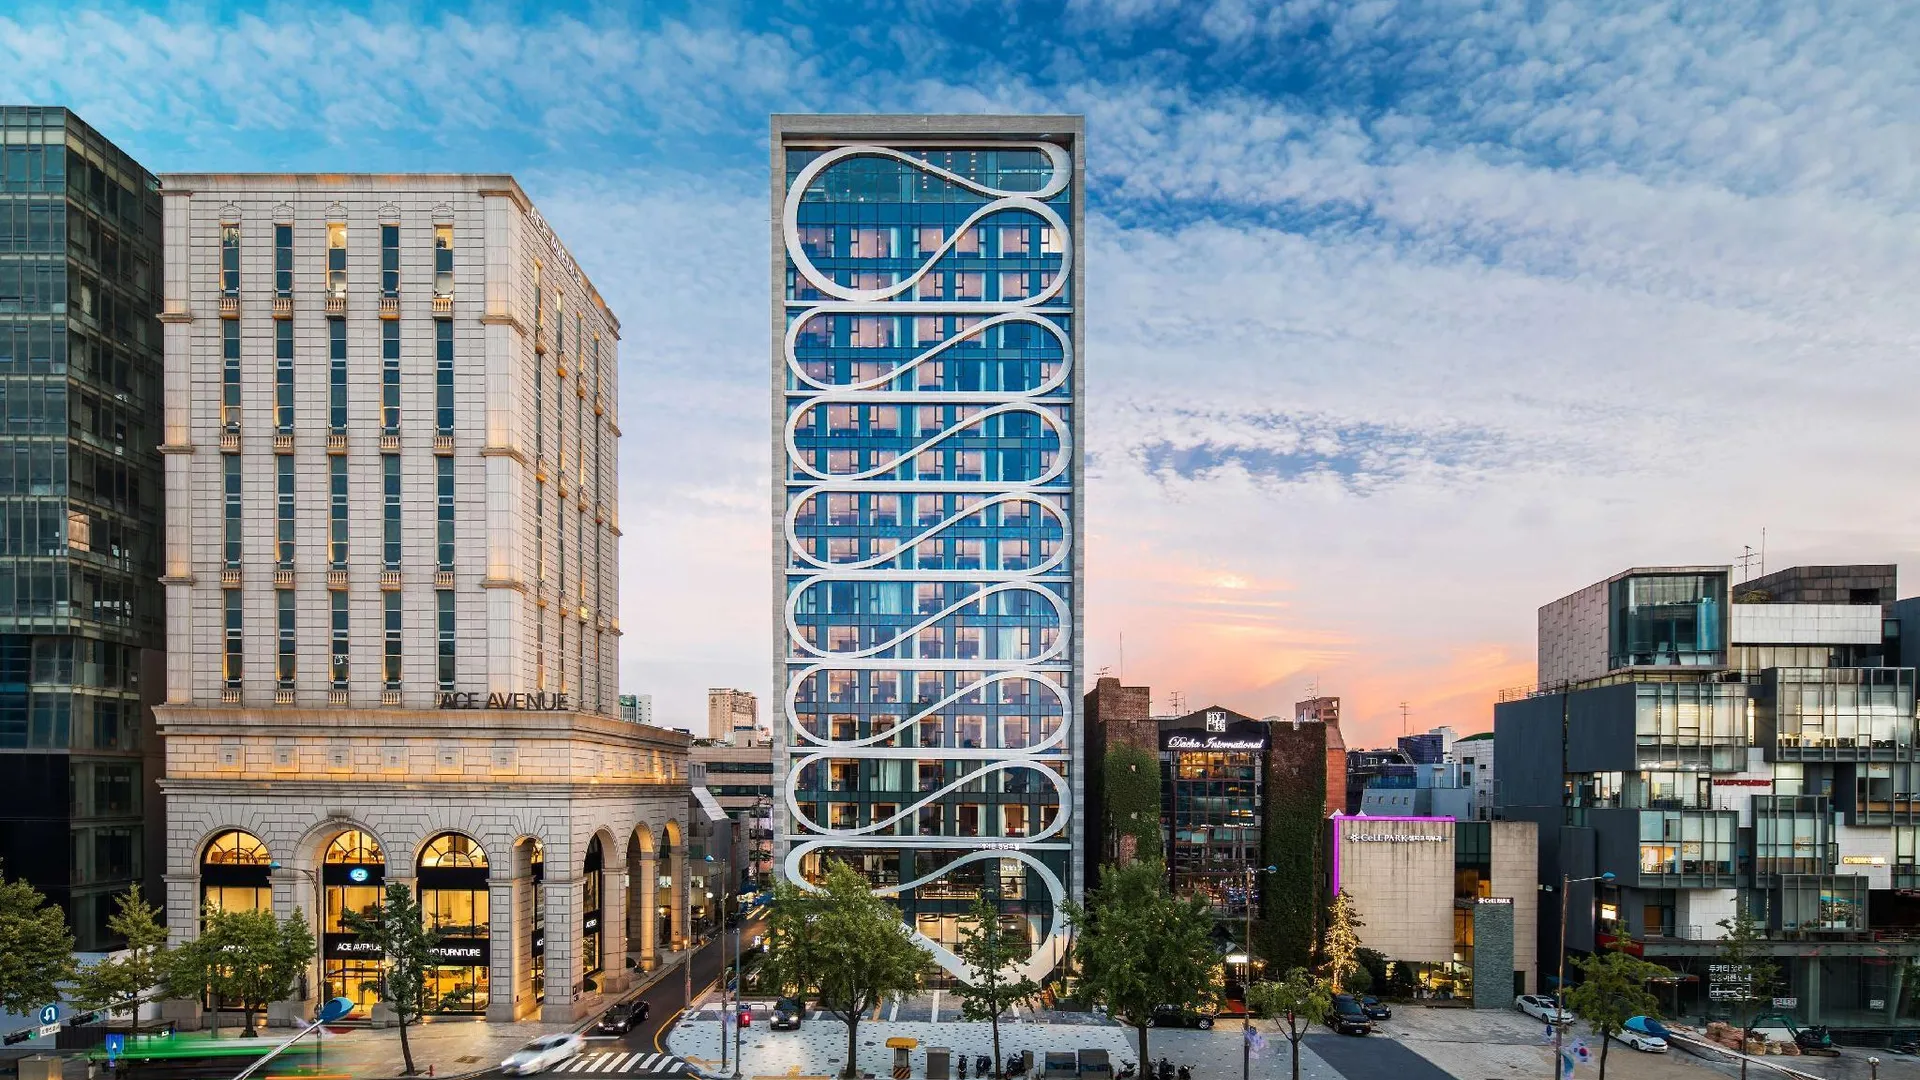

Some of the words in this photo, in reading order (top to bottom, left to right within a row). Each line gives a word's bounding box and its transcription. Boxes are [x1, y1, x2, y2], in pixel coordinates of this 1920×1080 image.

[440, 692, 480, 709] ACE
[484, 692, 569, 711] AVENUE
[1201, 737, 1264, 749] International
[1384, 834, 1407, 842] PARK
[337, 943, 351, 951] ACE
[440, 948, 481, 957] FURNITURE
